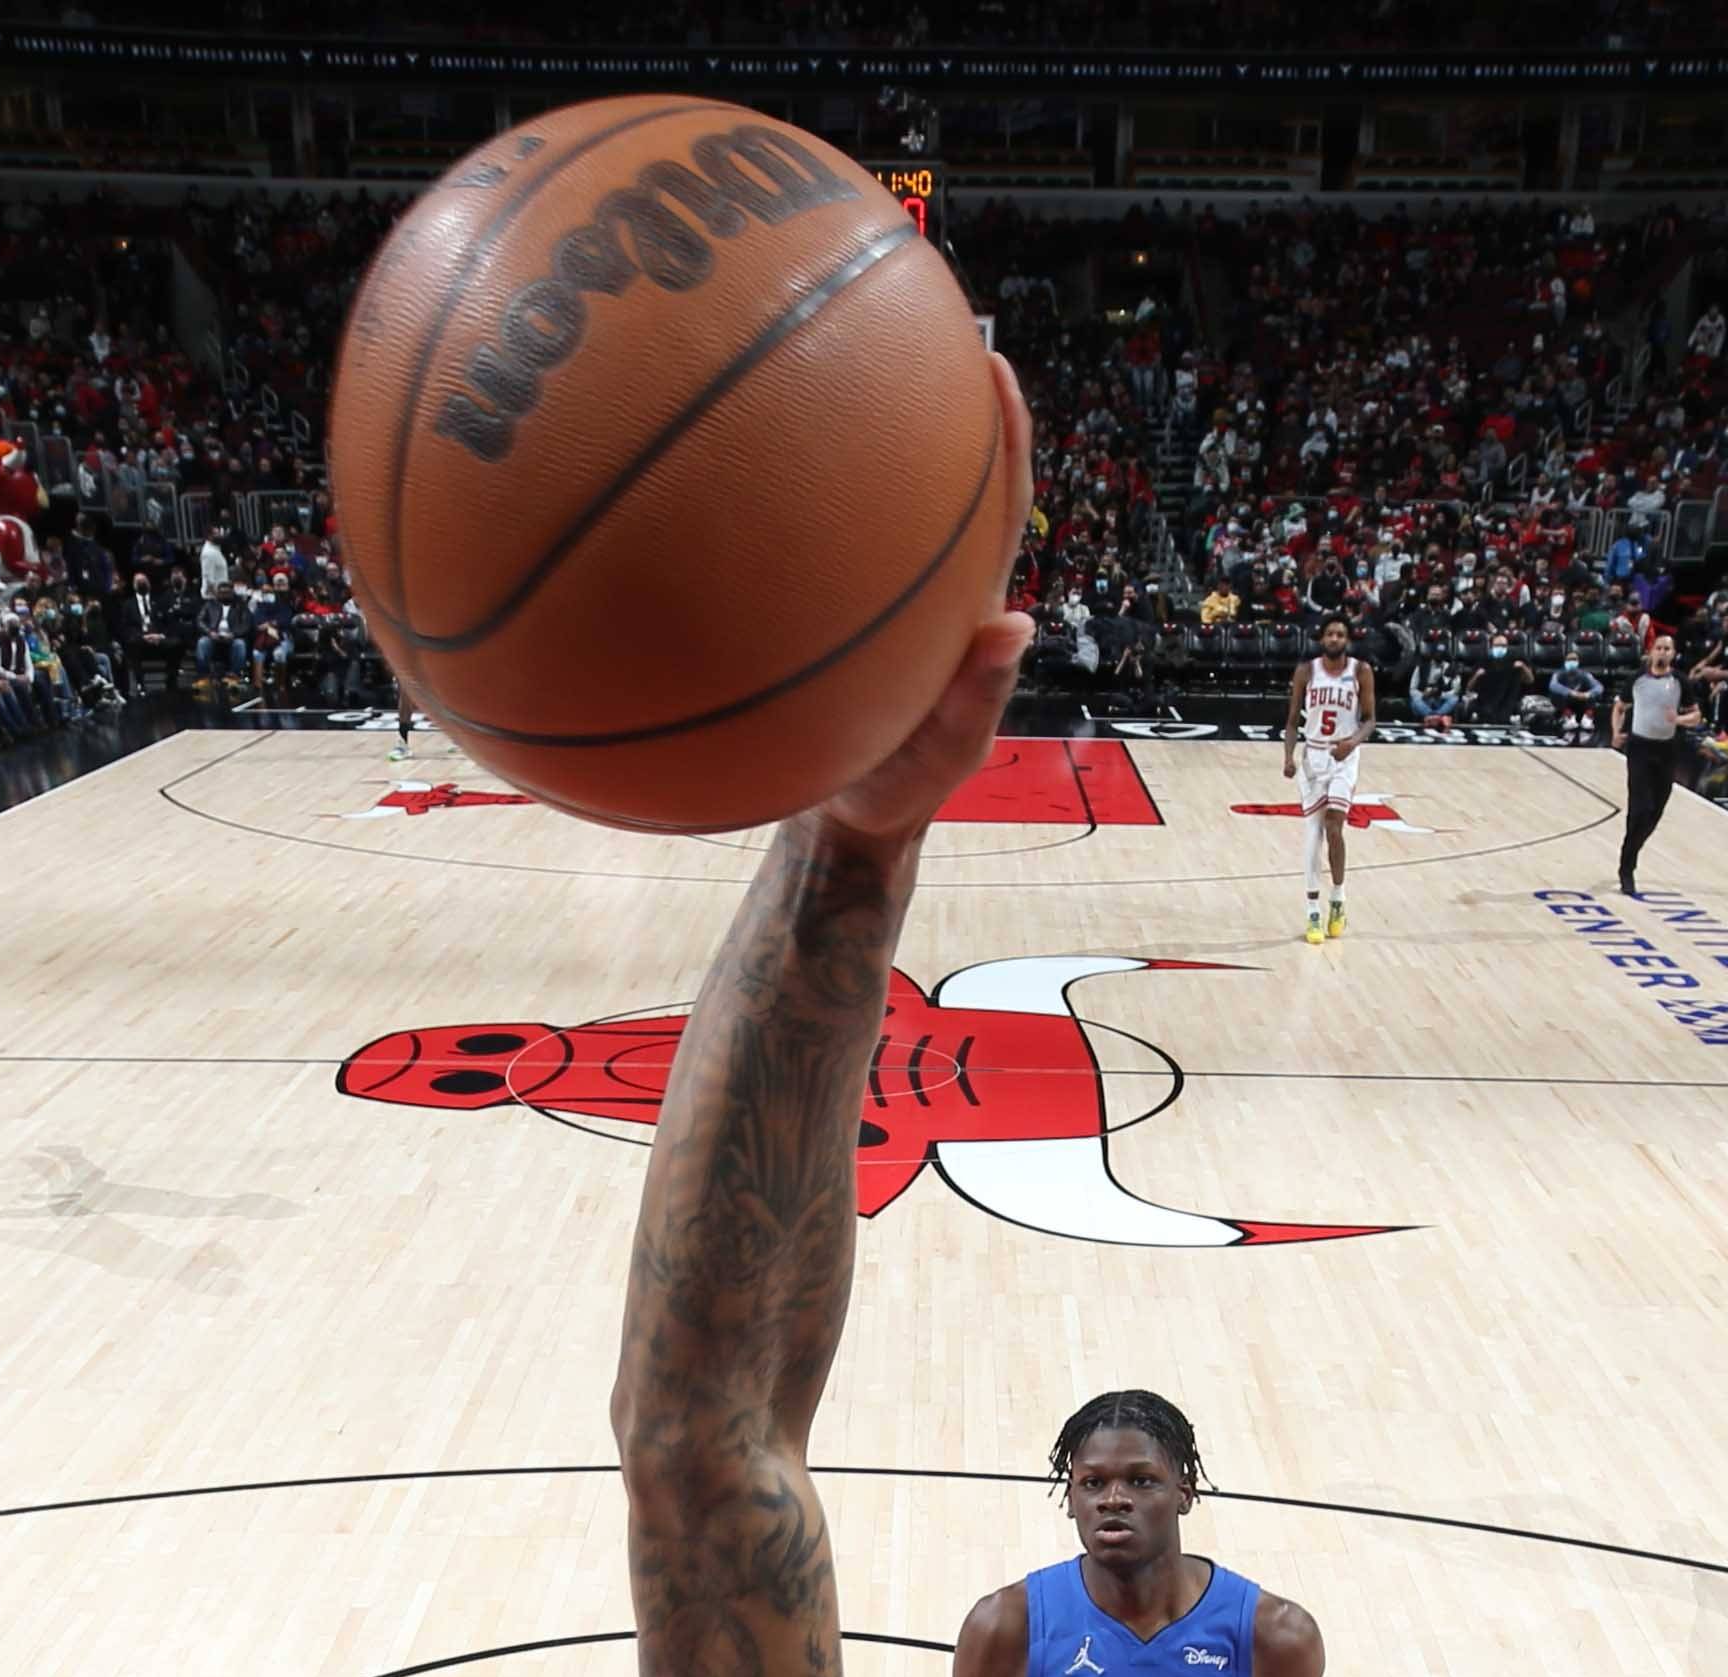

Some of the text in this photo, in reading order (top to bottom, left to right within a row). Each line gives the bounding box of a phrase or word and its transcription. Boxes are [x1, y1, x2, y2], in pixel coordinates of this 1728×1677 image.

[1309, 686, 1354, 711] BULLS
[1320, 710, 1337, 736] 5
[1533, 889, 1700, 989] CENTER
[1183, 1645, 1229, 1672] Disney
